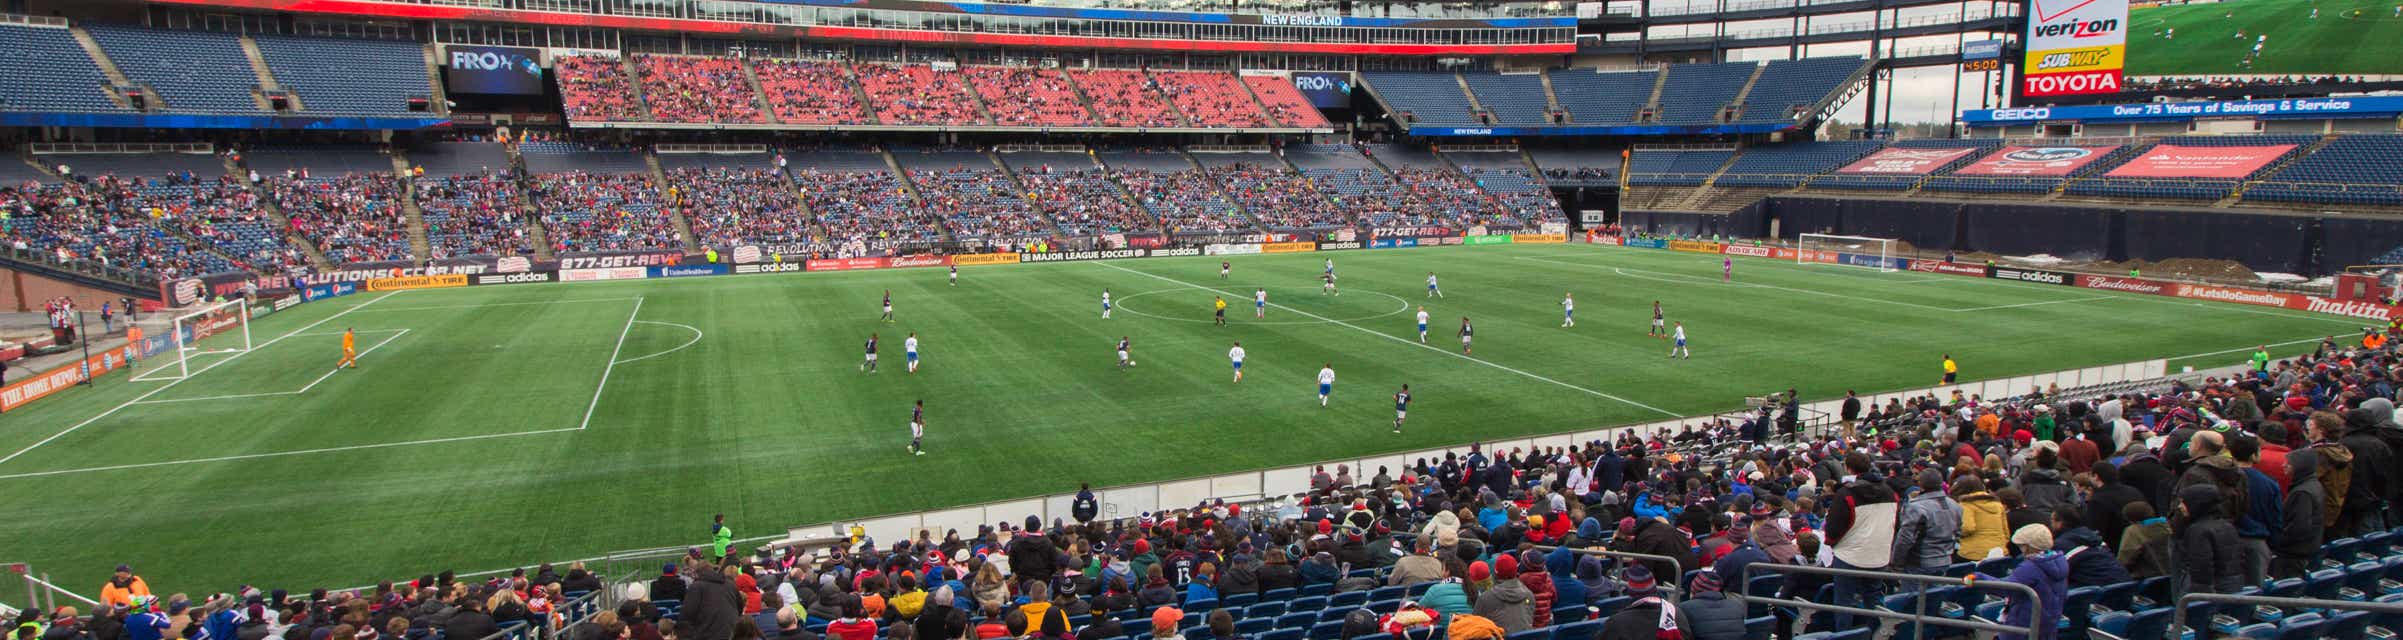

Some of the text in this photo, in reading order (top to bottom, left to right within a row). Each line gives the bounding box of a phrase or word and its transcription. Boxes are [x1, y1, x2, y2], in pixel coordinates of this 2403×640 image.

[1262, 15, 1342, 26] NEW ENGLAND
[2035, 18, 2118, 38] verizon
[2038, 48, 2111, 69] SUBWAY
[2026, 73, 2117, 93] TOYOTA
[1992, 107, 2051, 120] GEICO
[2113, 99, 2351, 115] Over 75 Years of Savings & Service
[1170, 247, 1199, 256] adidas
[1337, 241, 1360, 249] adidas
[1032, 252, 1064, 261] MAJOR
[1065, 250, 1099, 260] LEAGUE
[1101, 249, 1134, 258] SOCCER
[371, 276, 465, 290] Continental TIRE
[506, 272, 548, 283] adidas
[2021, 271, 2063, 284] adidas
[2086, 276, 2162, 293] Budweiser
[2192, 285, 2287, 307] #LetsDoGameDay
[2, 387, 23, 407] THE
[22, 377, 51, 399] HOME
